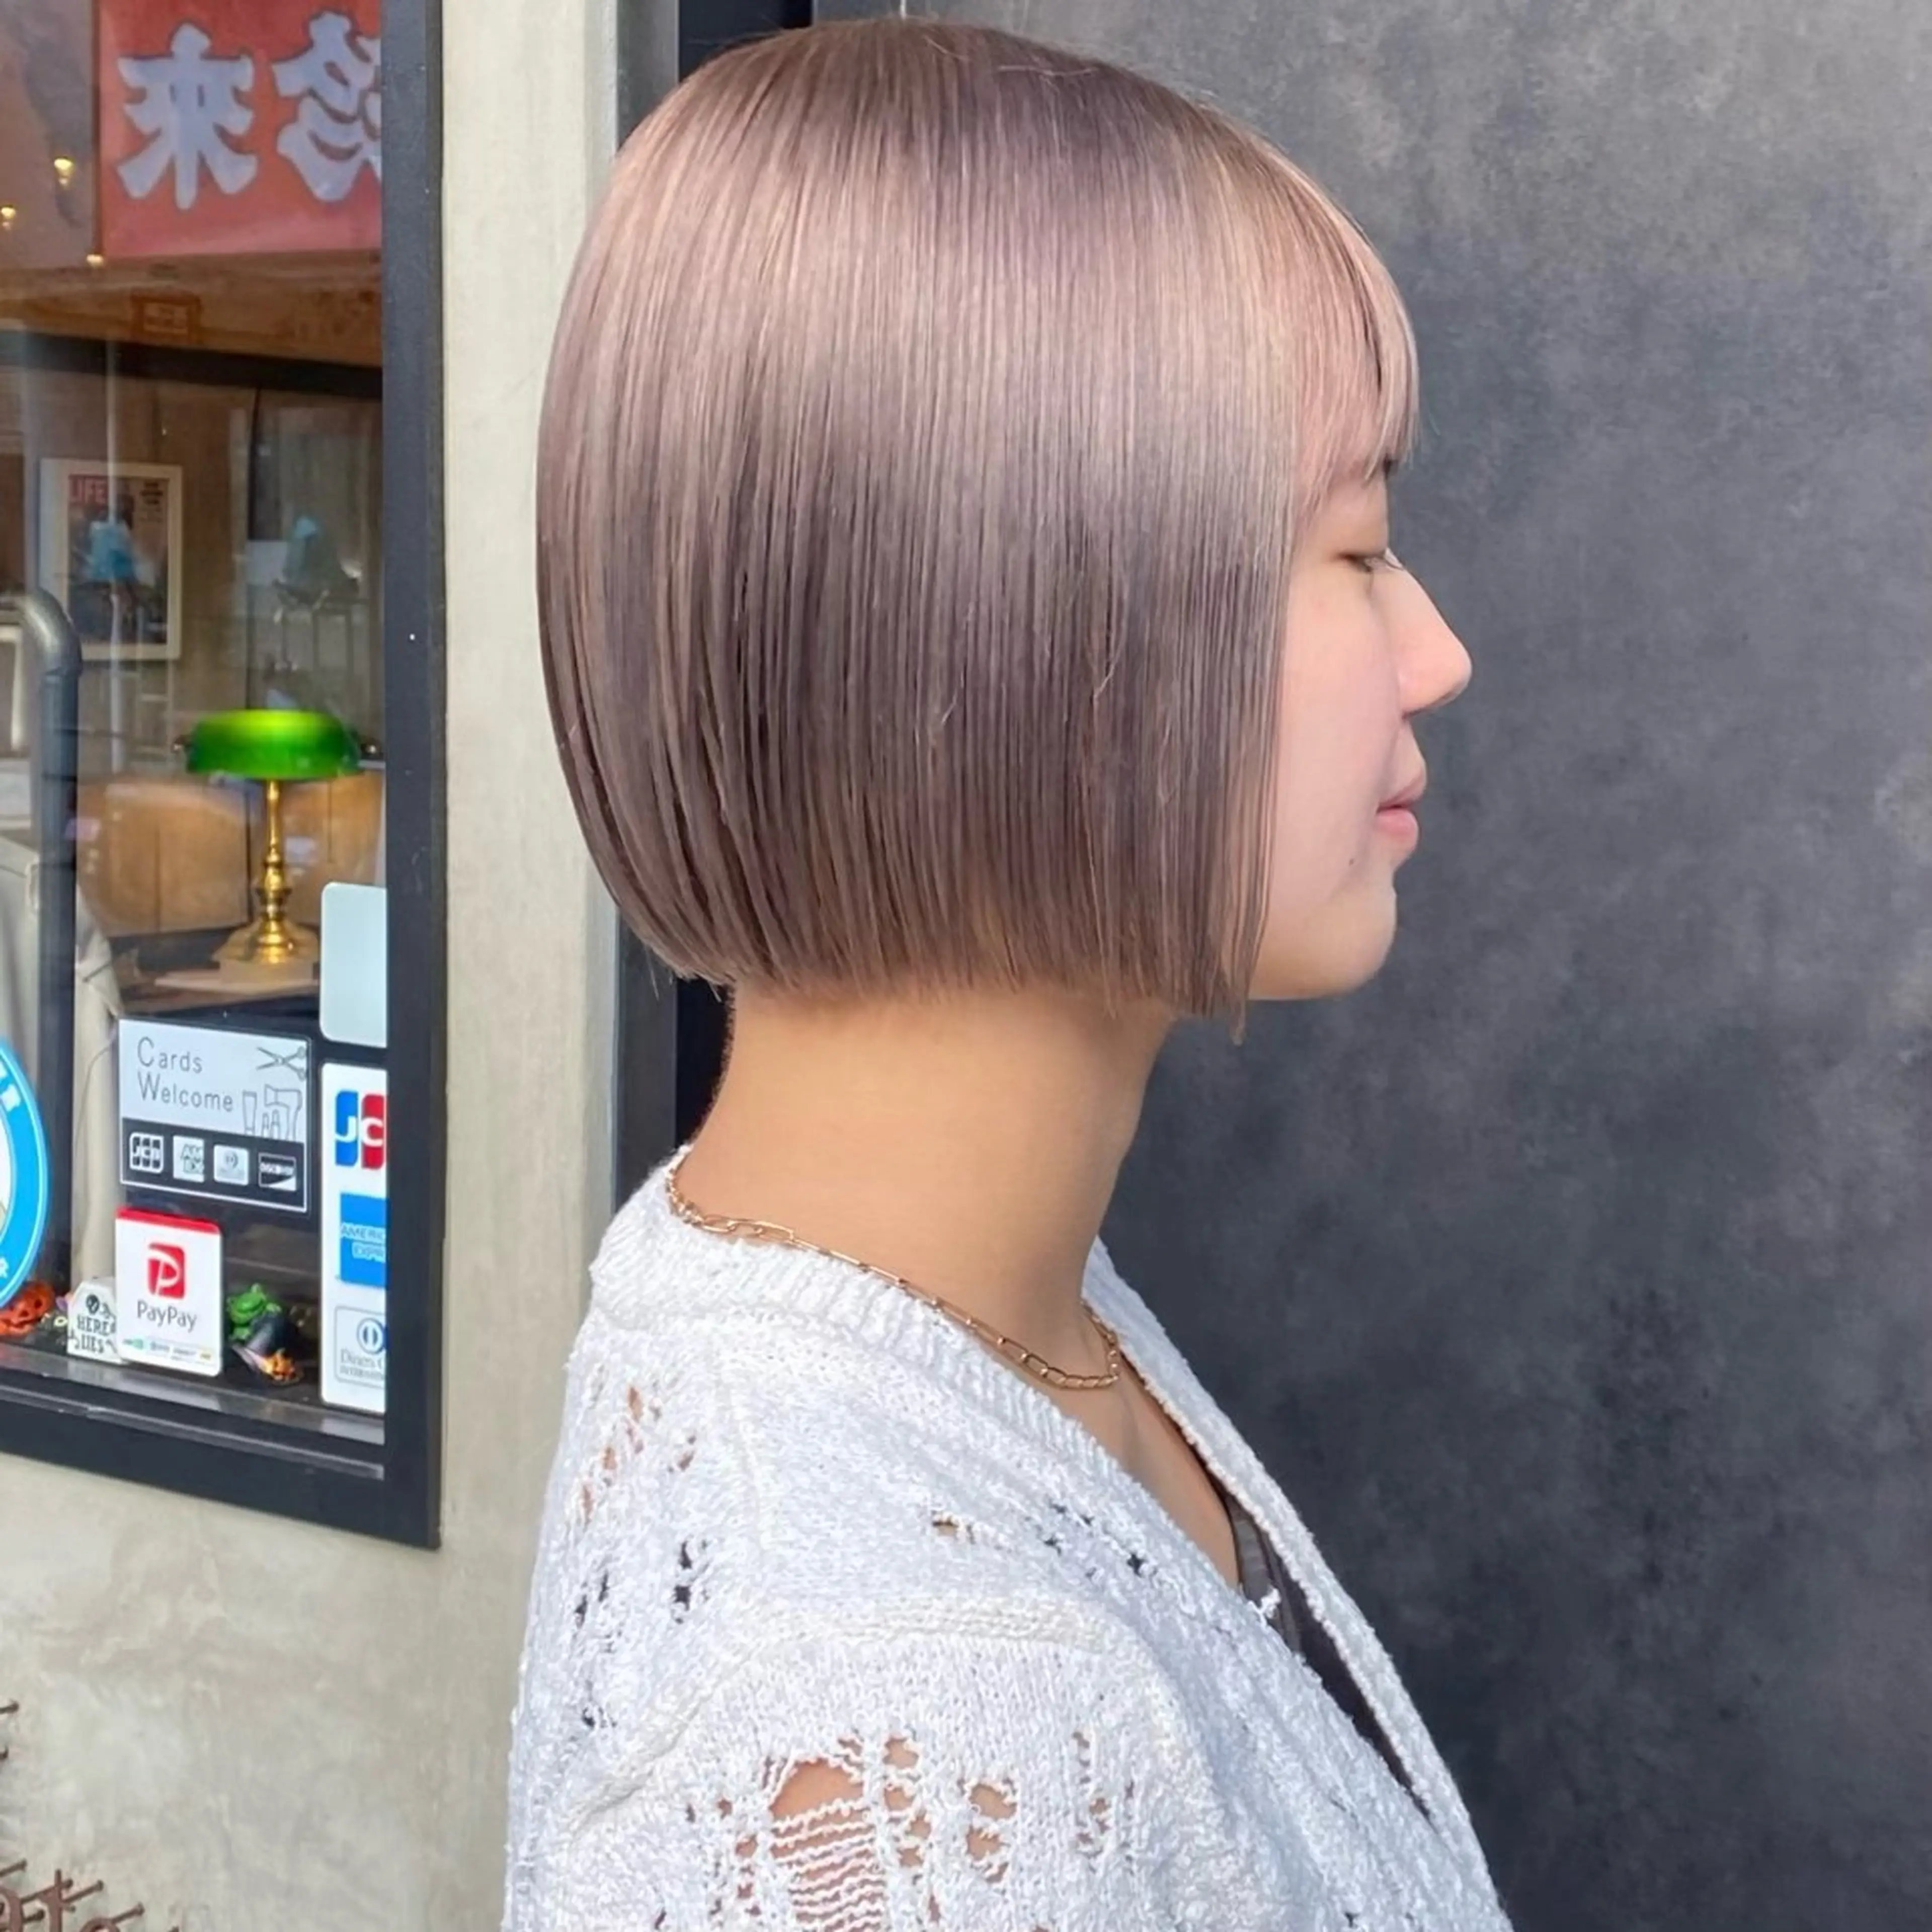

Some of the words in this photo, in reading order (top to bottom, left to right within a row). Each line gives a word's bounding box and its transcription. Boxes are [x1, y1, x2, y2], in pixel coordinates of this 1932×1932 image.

[68, 476, 108, 504] LIFE
[137, 1036, 202, 1073] Cards
[137, 1072, 233, 1112] Welcome
[137, 1298, 197, 1333] PayPay
